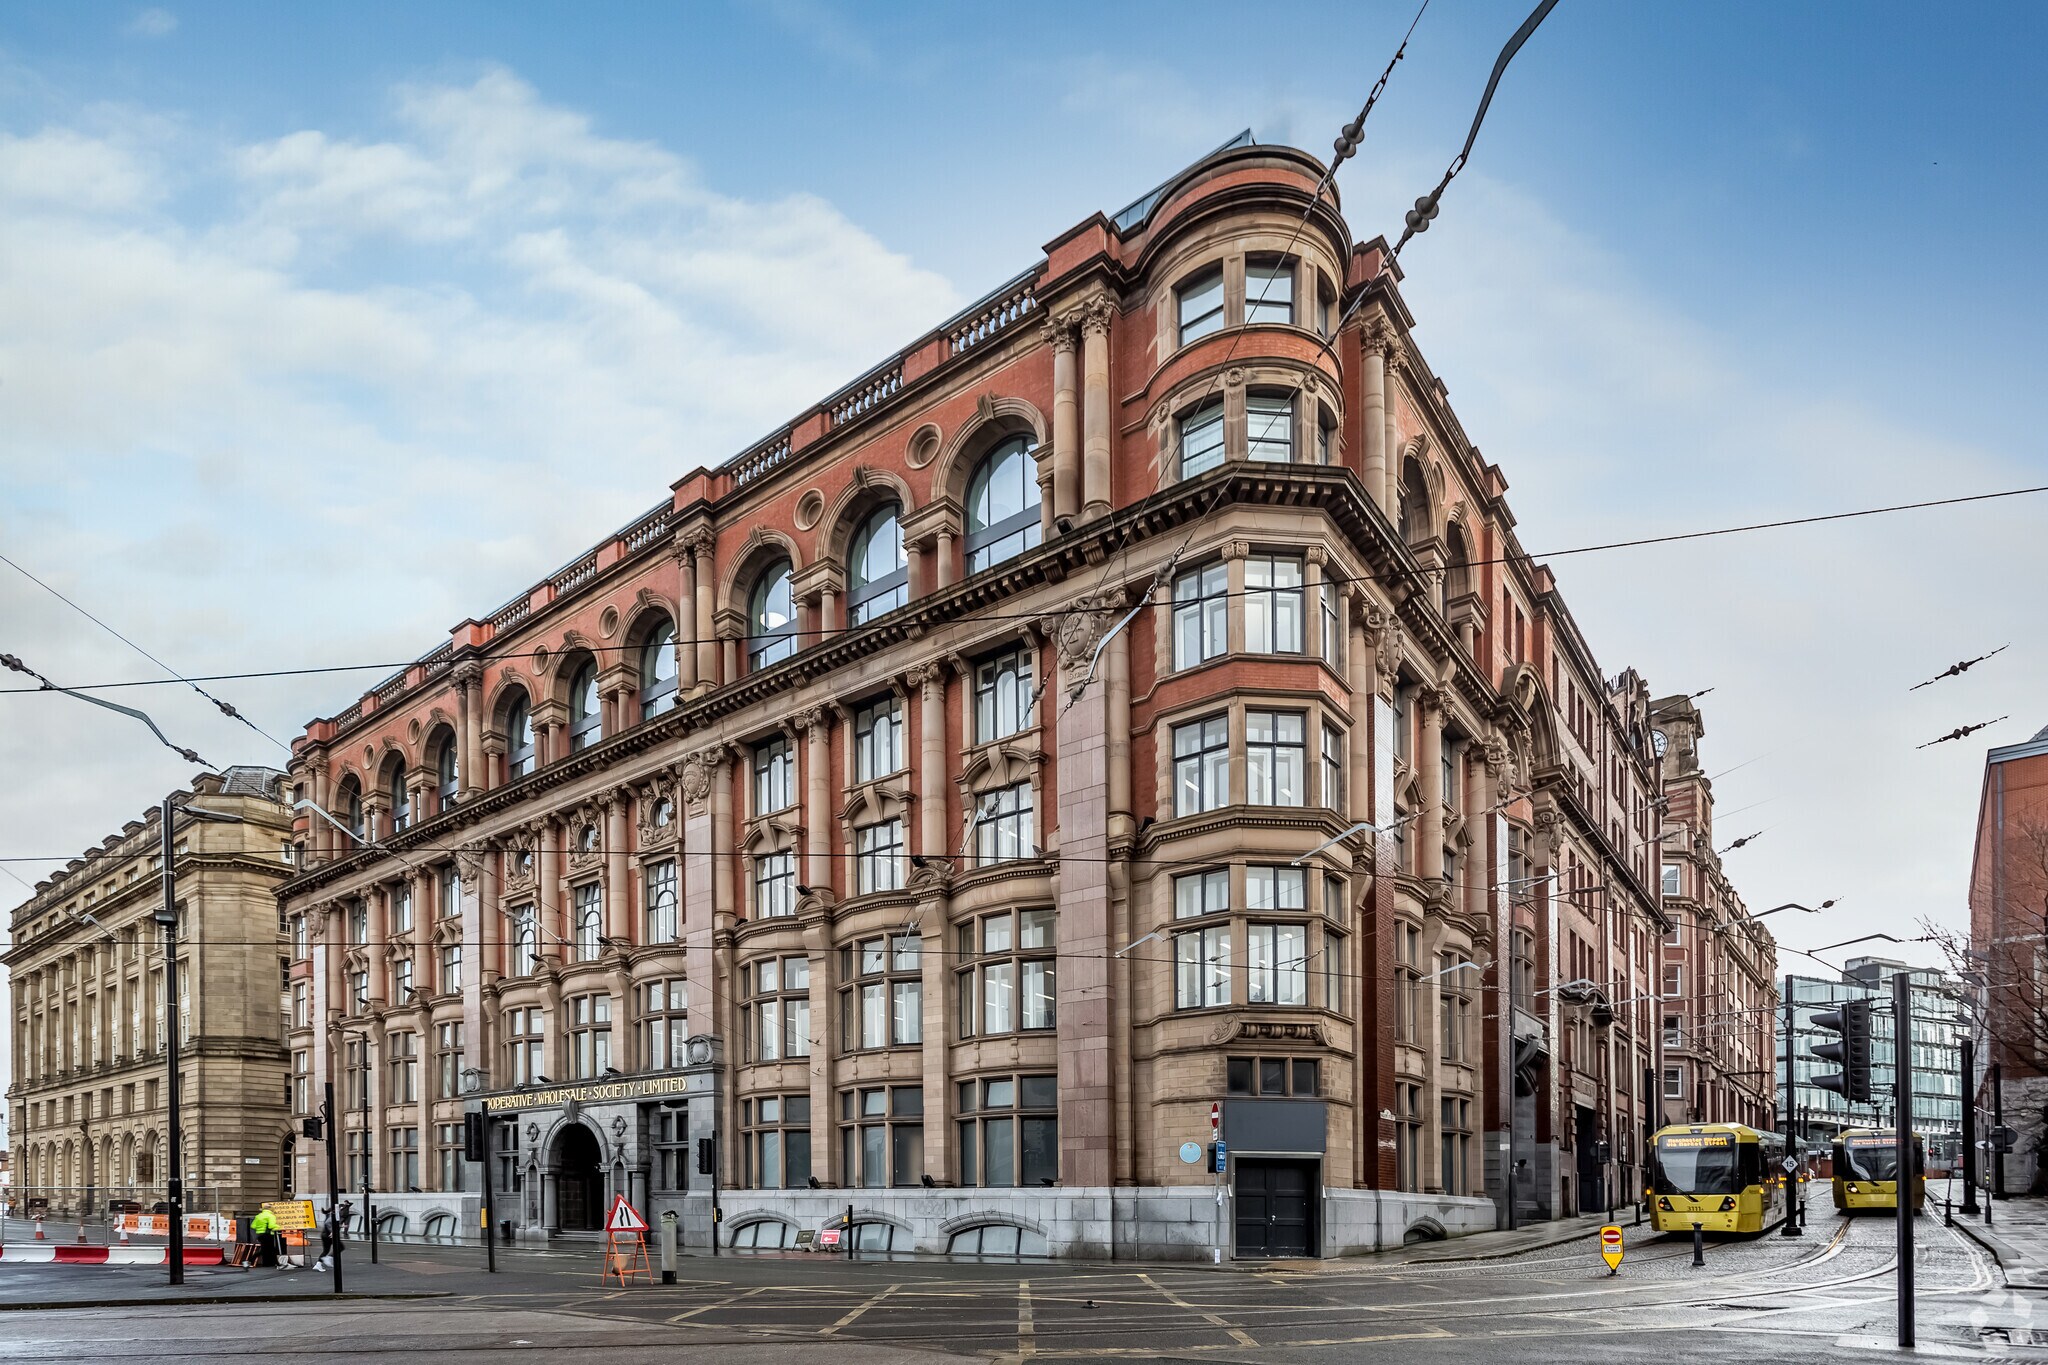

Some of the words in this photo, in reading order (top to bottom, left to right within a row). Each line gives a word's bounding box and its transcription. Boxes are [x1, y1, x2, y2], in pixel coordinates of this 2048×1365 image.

[481, 1094, 533, 1110] OOPERATIVE
[537, 1087, 587, 1105] WHOLESALE
[593, 1082, 636, 1099] SOCIETY
[642, 1077, 687, 1094] LIMITED
[1785, 1160, 1795, 1168] 15
